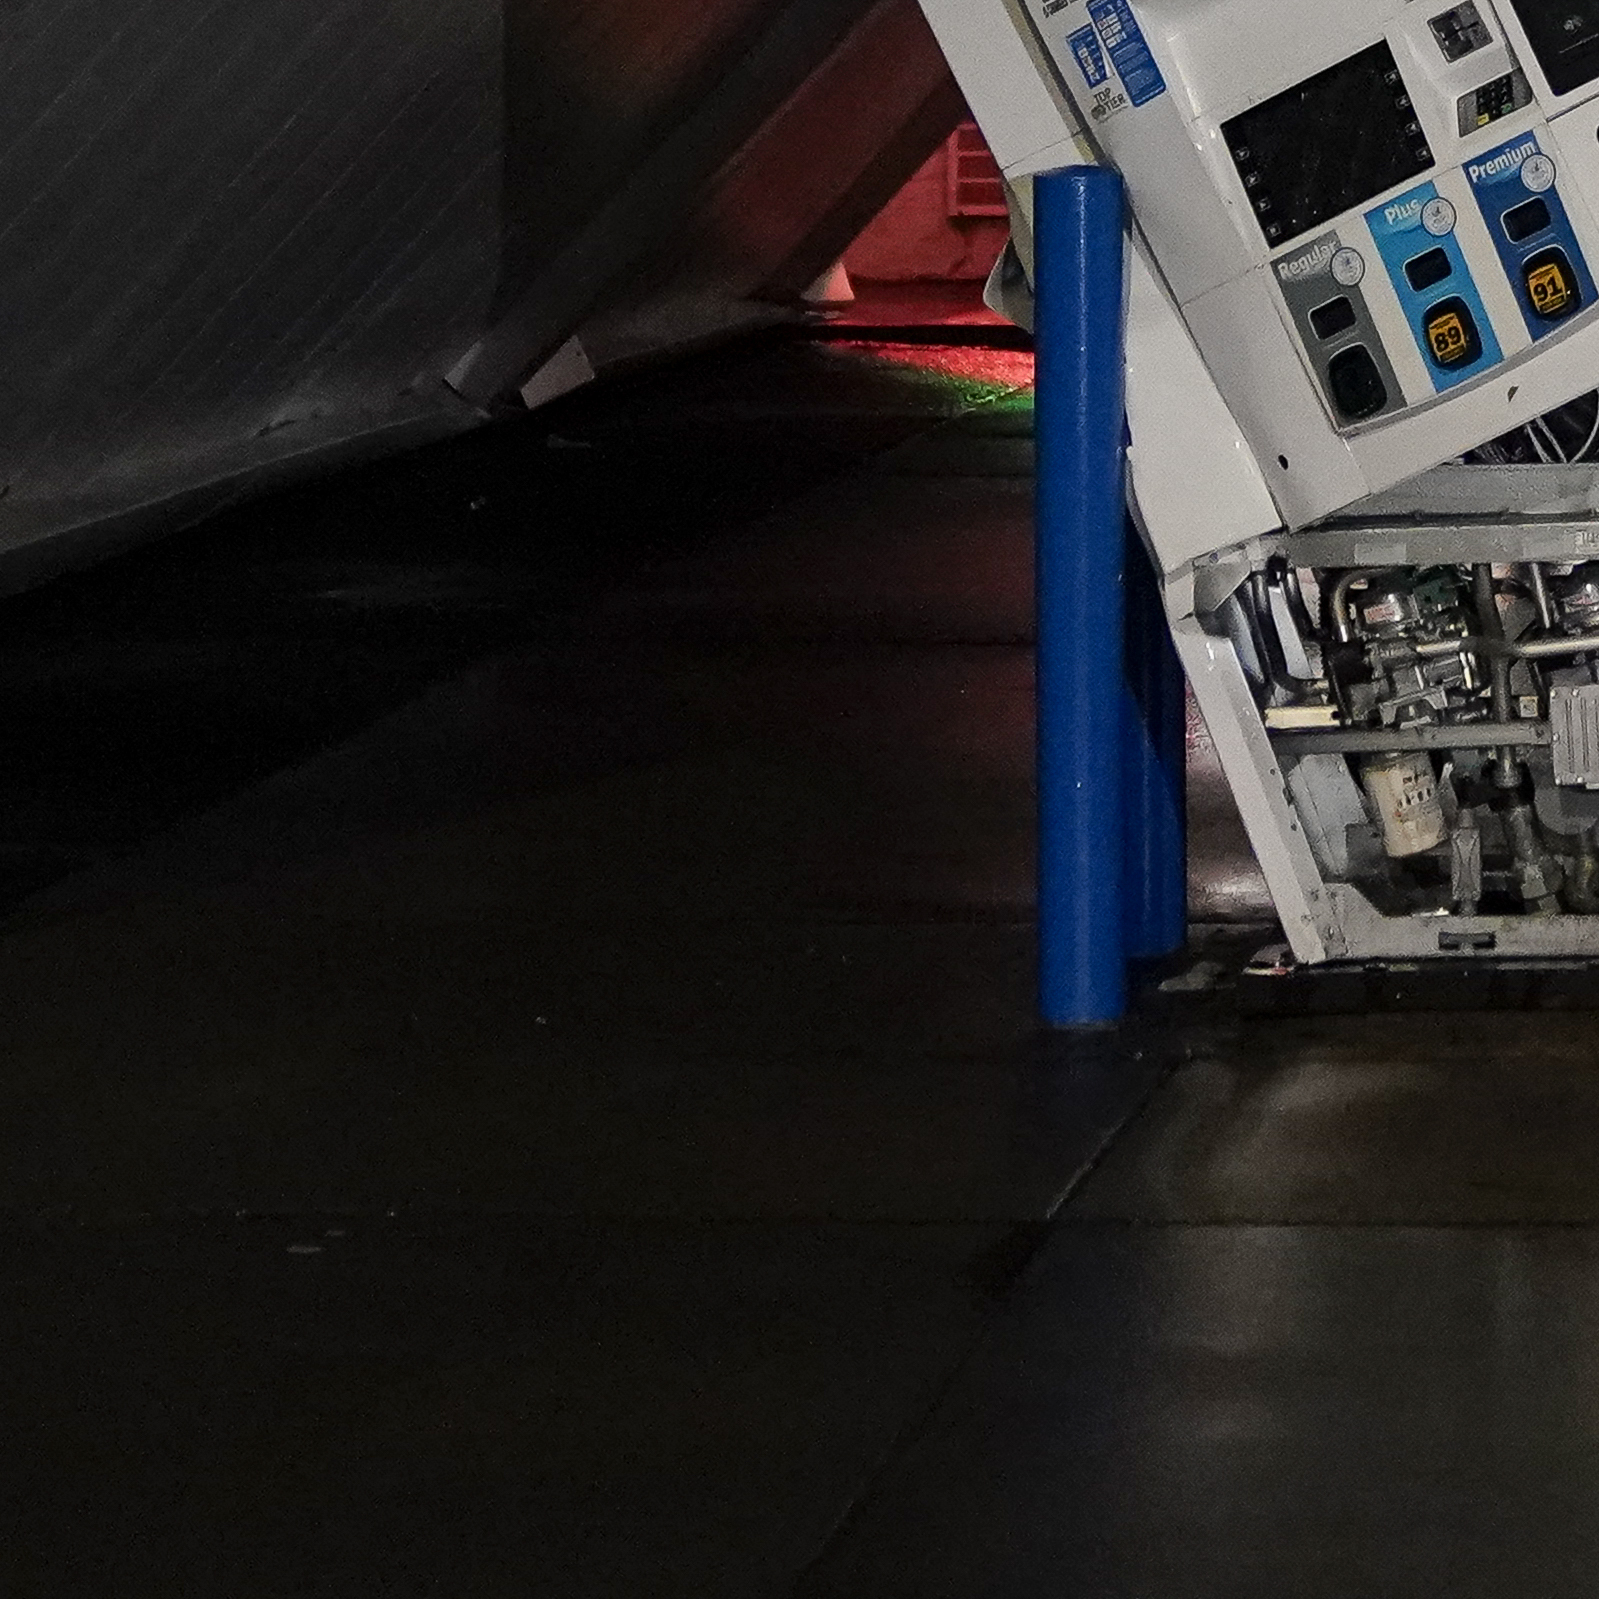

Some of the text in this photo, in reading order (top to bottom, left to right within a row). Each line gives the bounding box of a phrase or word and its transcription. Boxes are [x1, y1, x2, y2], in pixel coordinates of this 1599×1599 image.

[1467, 141, 1537, 184] Premium
[1277, 239, 1338, 281] Regular
[1533, 275, 1563, 303] 91
[1433, 325, 1462, 353] 89
